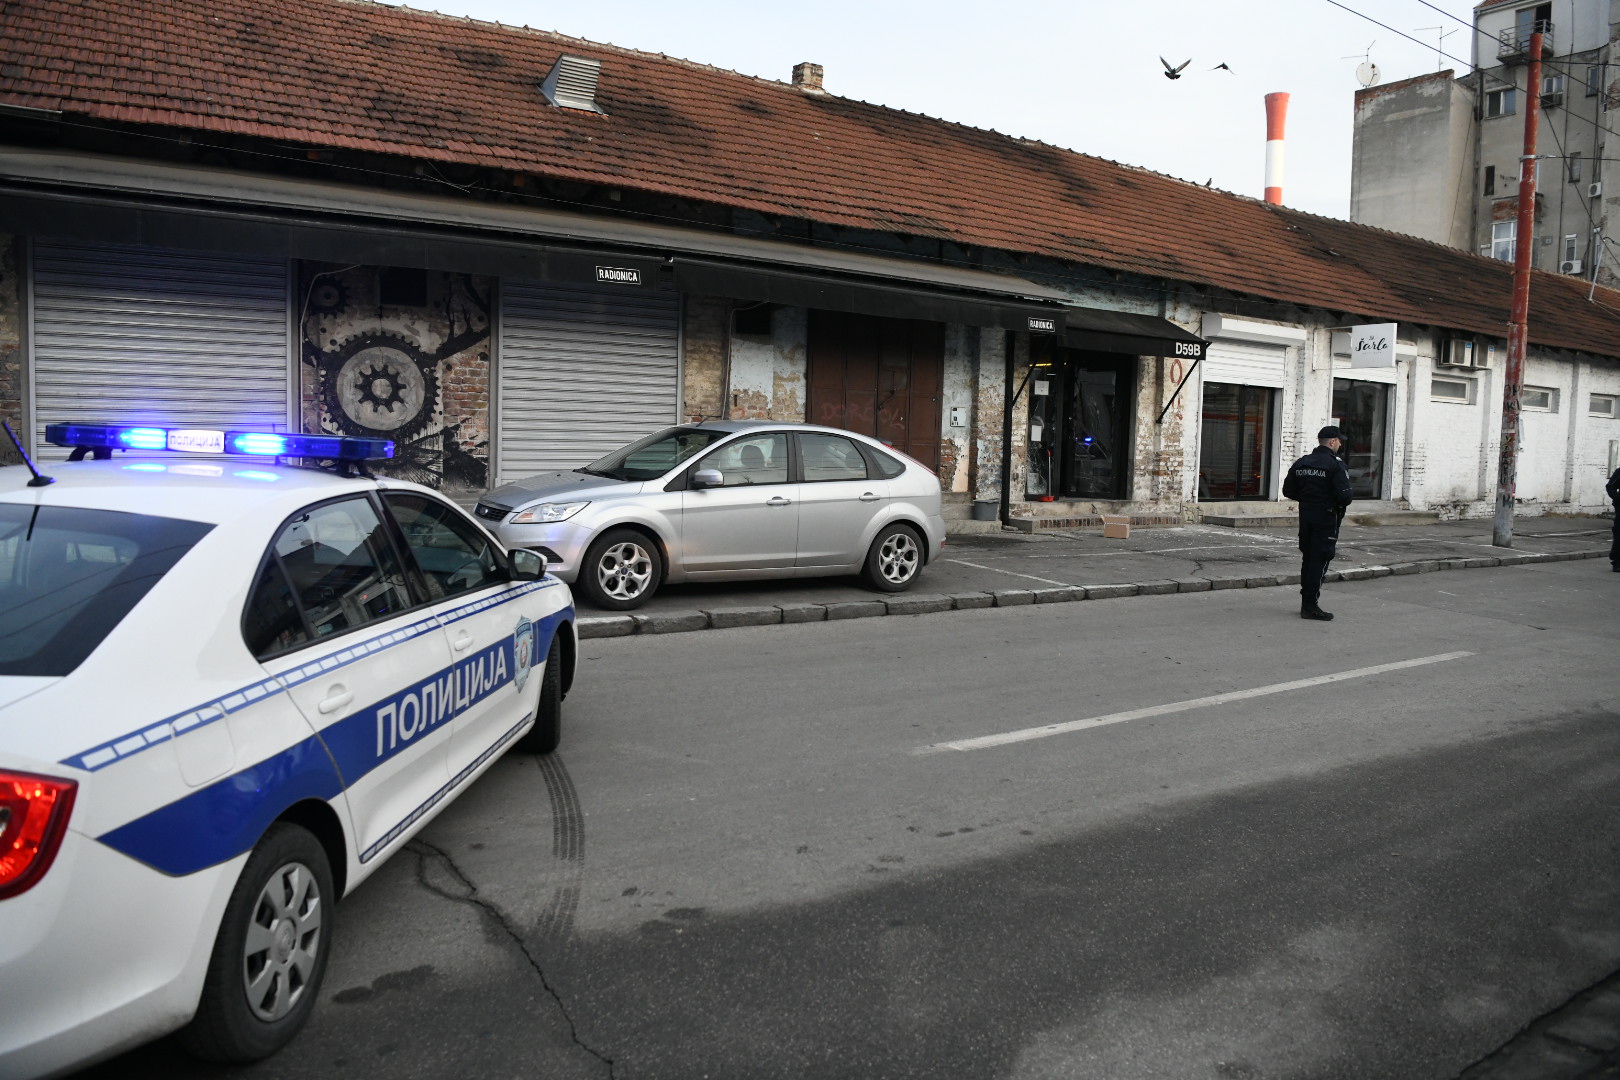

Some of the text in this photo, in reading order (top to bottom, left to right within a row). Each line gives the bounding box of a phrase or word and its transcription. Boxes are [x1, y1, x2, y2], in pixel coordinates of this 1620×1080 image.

[599, 269, 638, 282] RADIONICA
[1175, 342, 1201, 356] D59B
[169, 435, 221, 447] ПОЛИЦИЈА
[376, 646, 507, 758] ПОЛИЦИЈА
